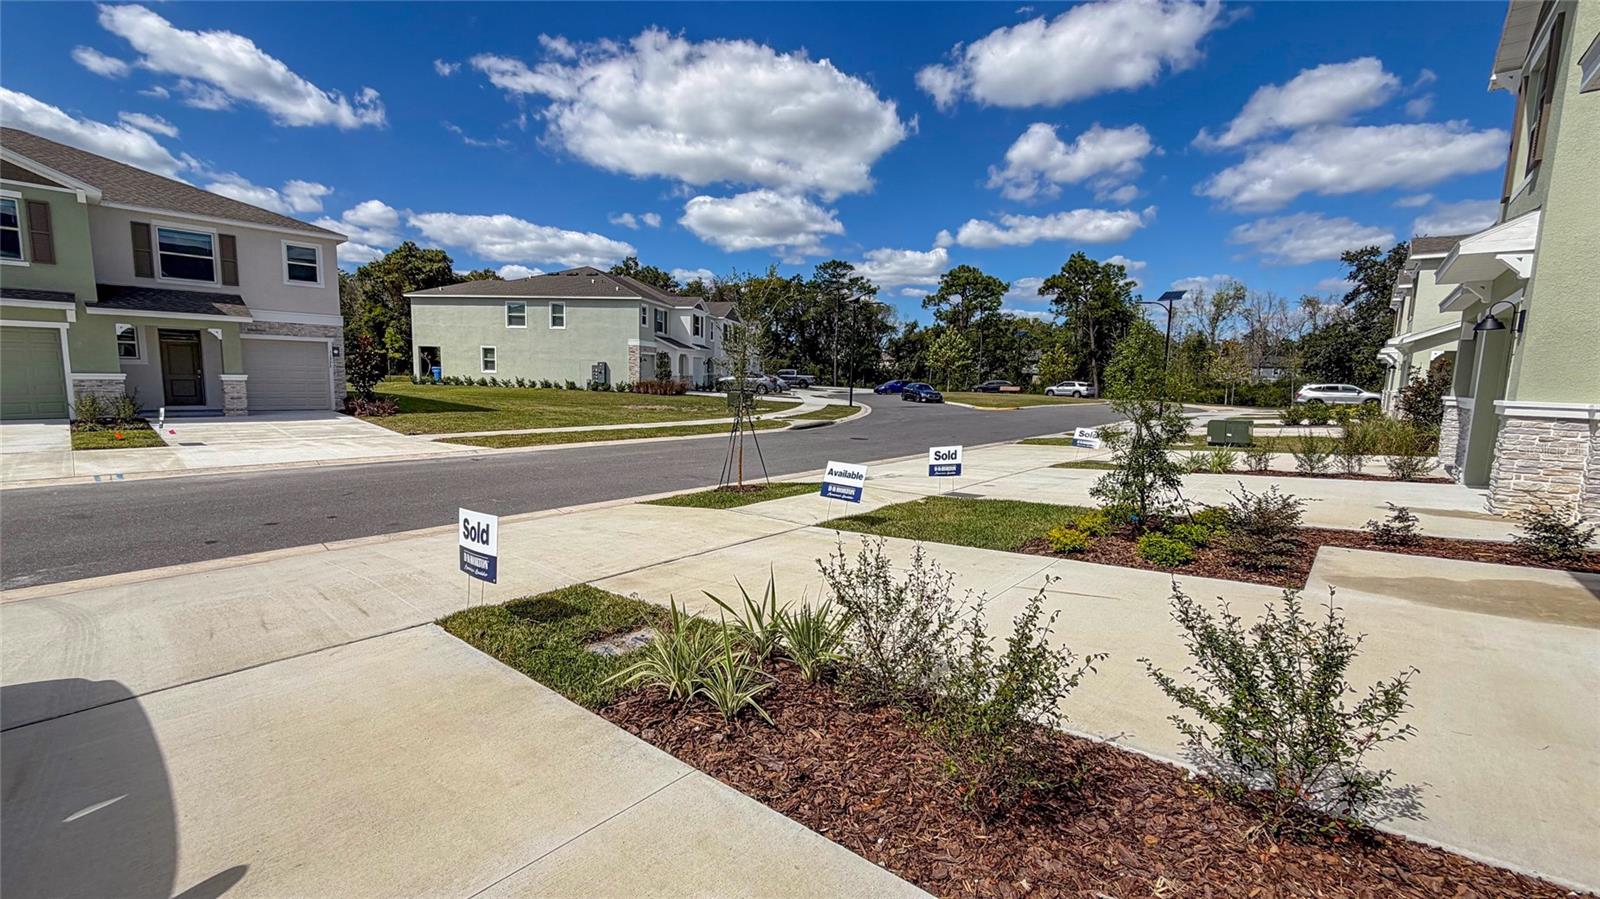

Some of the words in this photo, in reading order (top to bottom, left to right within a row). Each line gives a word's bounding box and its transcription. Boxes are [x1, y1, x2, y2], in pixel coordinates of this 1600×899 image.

[934, 450, 957, 461] Sold
[827, 467, 864, 481] Available
[462, 517, 490, 546] Sold
